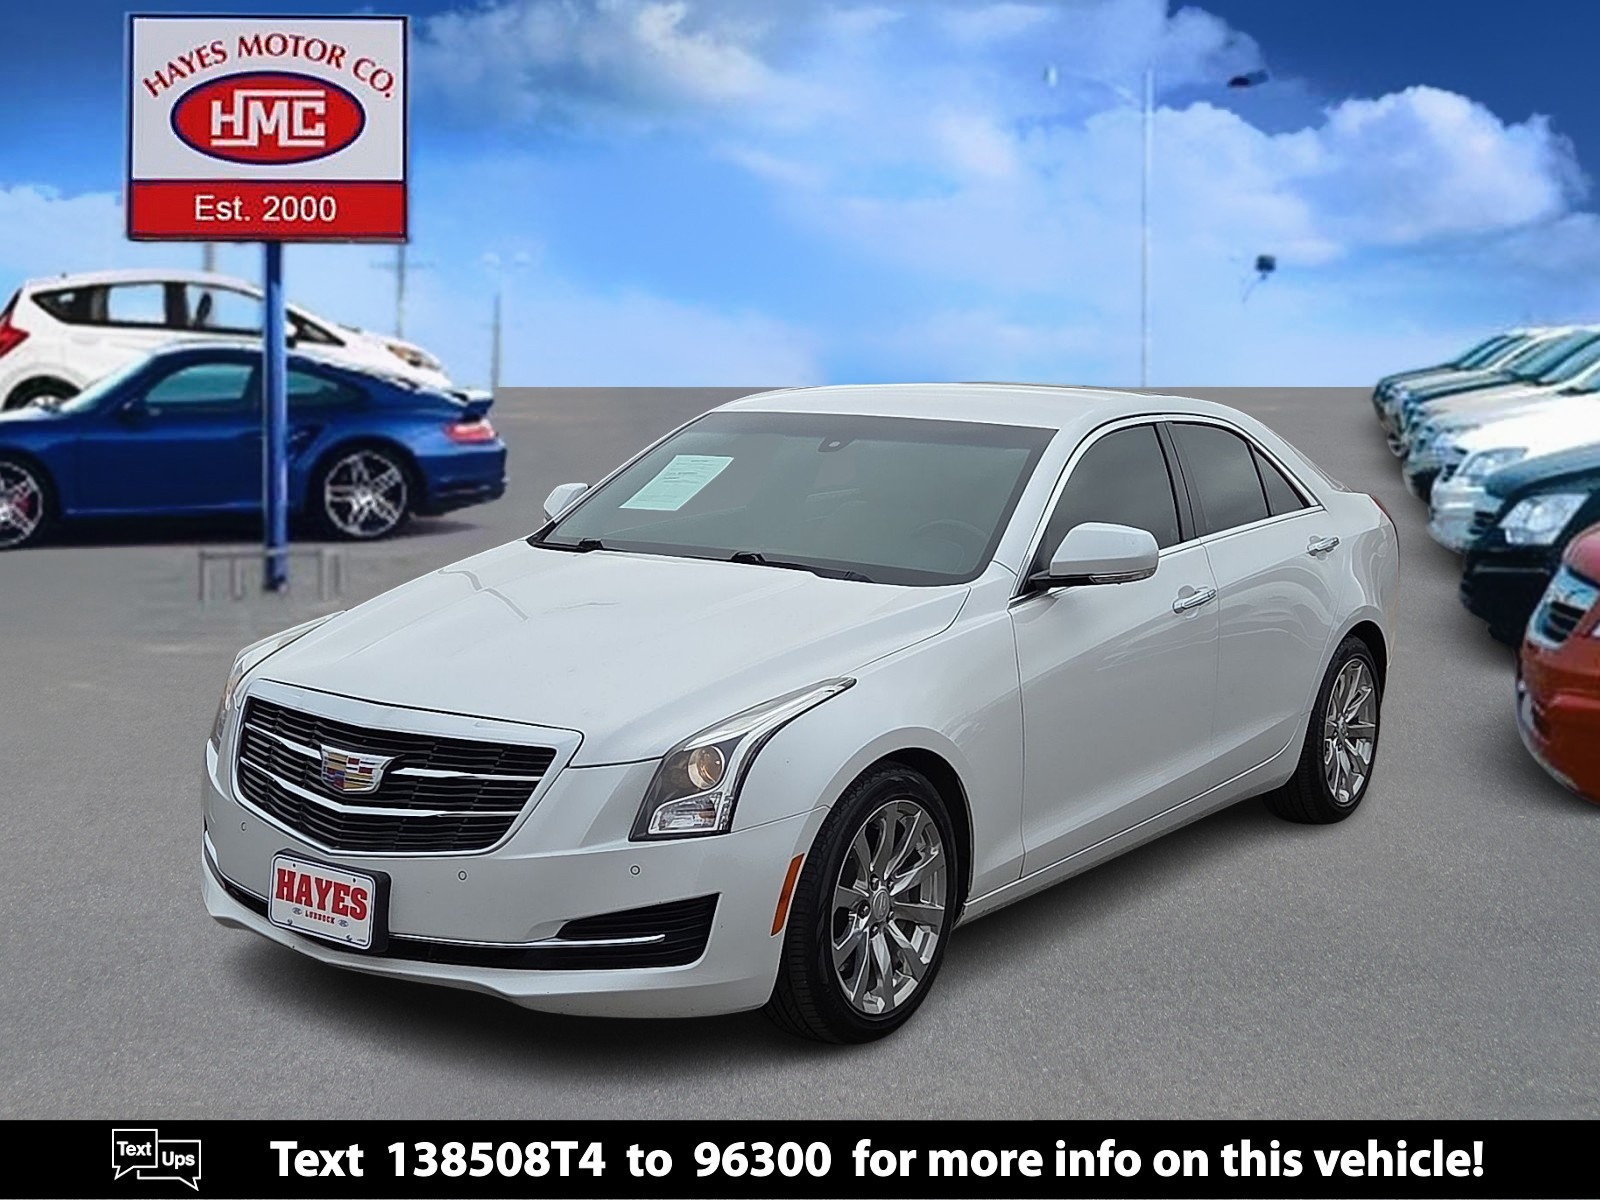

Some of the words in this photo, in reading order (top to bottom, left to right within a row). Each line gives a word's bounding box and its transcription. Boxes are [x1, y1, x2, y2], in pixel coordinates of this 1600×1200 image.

[142, 40, 228, 98] HAYES
[238, 33, 346, 69] MOTOR
[352, 57, 395, 98] CO.
[210, 89, 326, 147] HMC
[195, 195, 250, 222] Est.
[263, 195, 337, 222] 2000
[275, 868, 368, 921] HAYES
